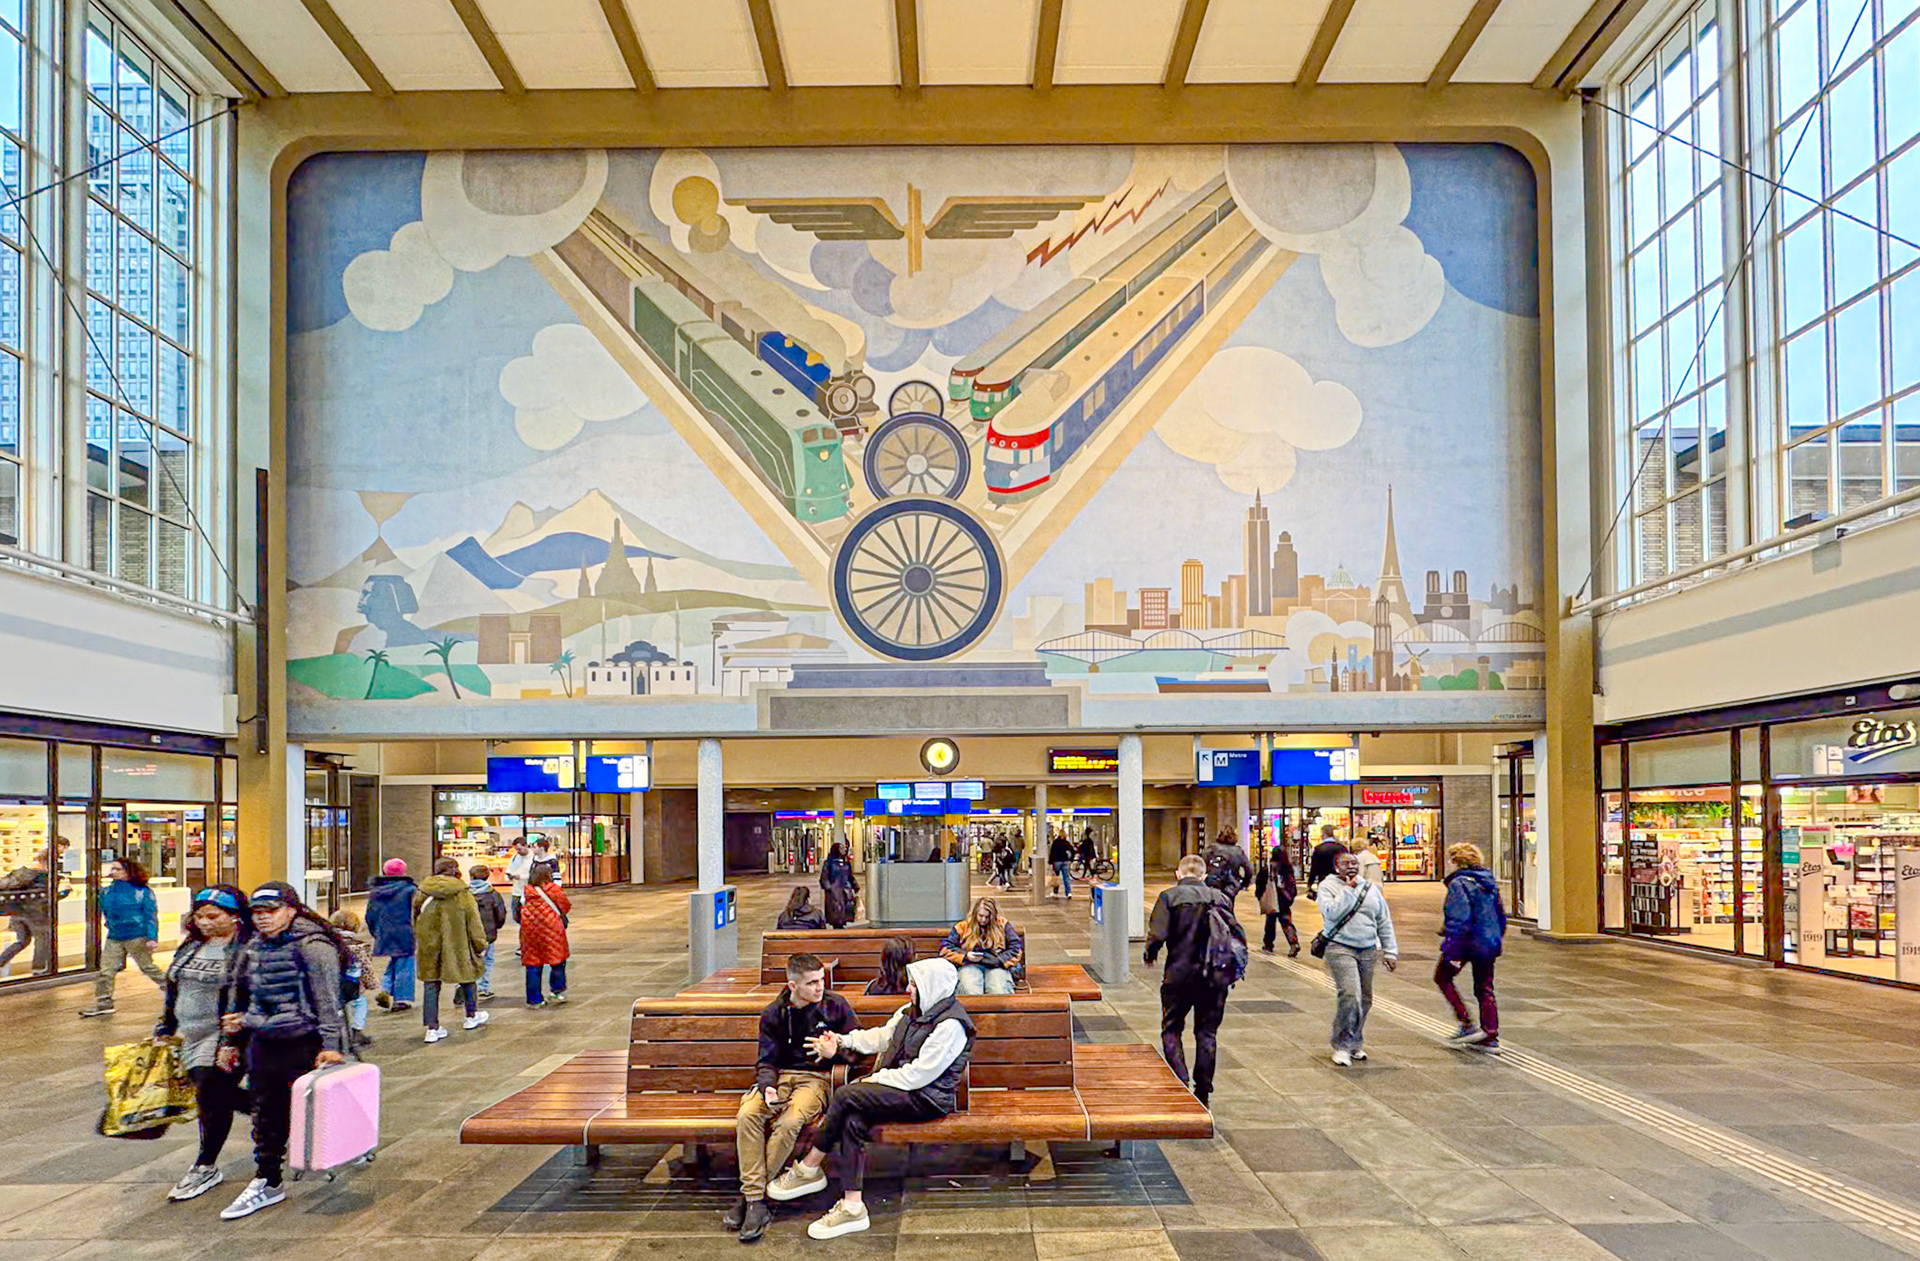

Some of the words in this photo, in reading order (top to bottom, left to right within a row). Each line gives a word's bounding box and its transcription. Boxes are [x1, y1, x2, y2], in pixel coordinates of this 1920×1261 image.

[1848, 717, 1917, 749] Etos
[1216, 757, 1226, 765] M
[1362, 788, 1414, 805] bruna
[1802, 861, 1822, 873] Etos
[1902, 864, 1920, 876] Eto
[1802, 933, 1823, 942] 1919
